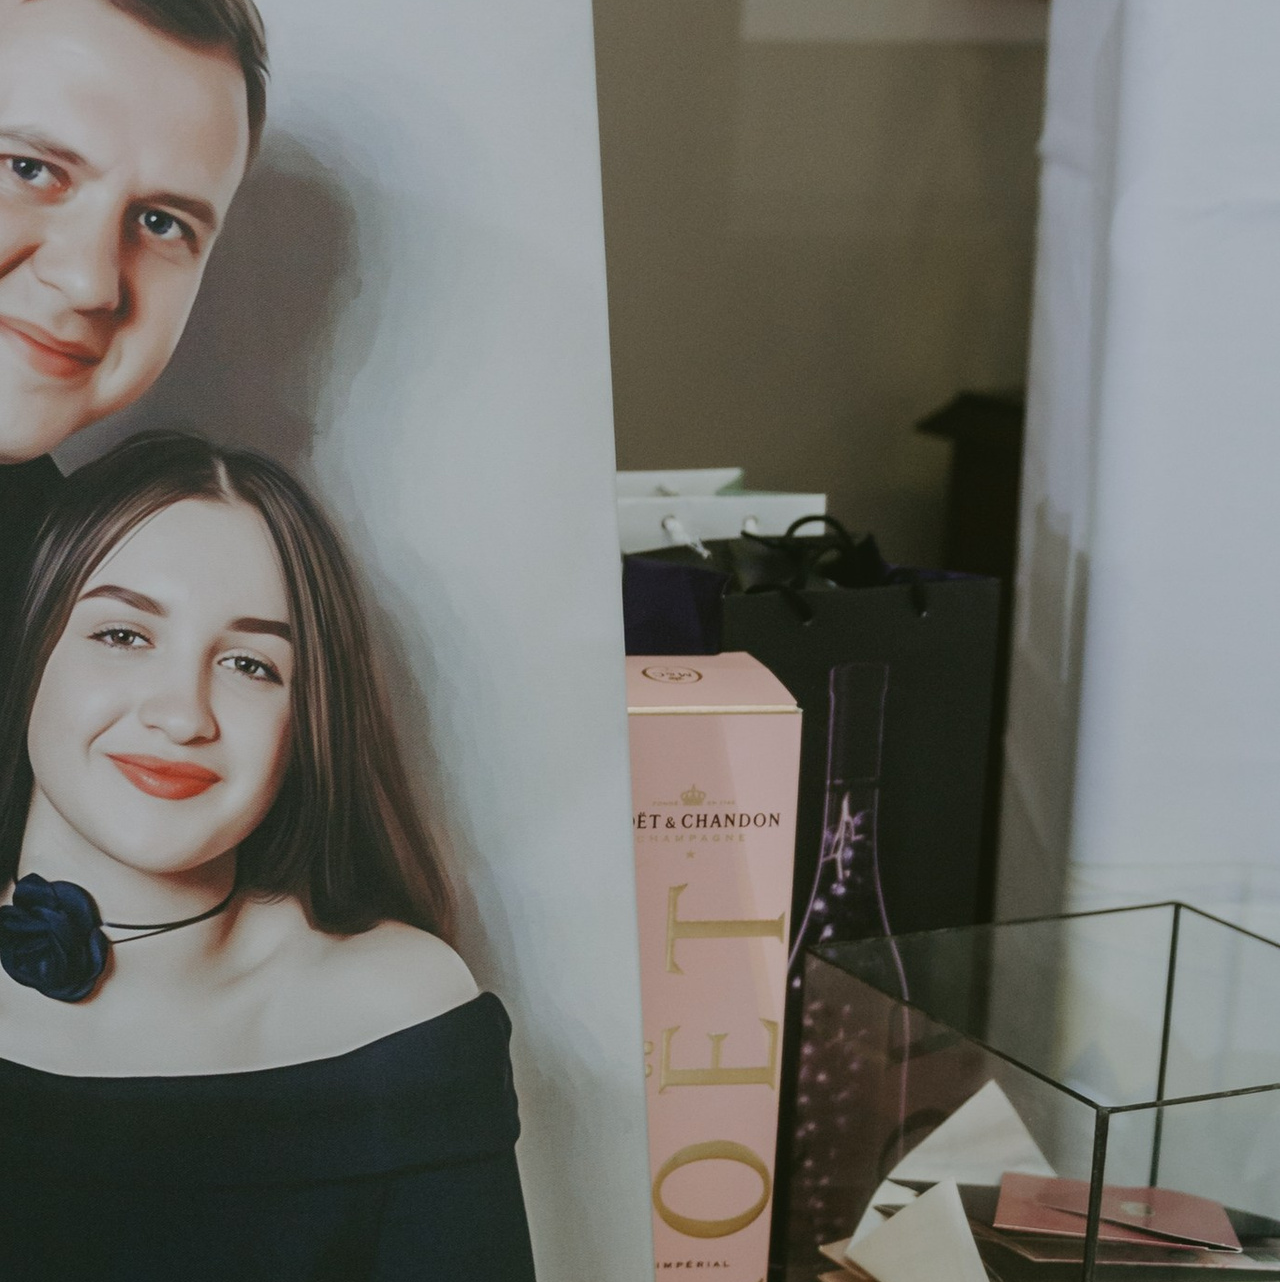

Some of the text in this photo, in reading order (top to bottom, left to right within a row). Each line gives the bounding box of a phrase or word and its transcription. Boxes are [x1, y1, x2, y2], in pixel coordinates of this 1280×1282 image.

[633, 811, 781, 829] ËT & CHANDON
[637, 834, 746, 843] CHAMPAGNE
[656, 1259, 731, 1269] IMPÉRIAL
